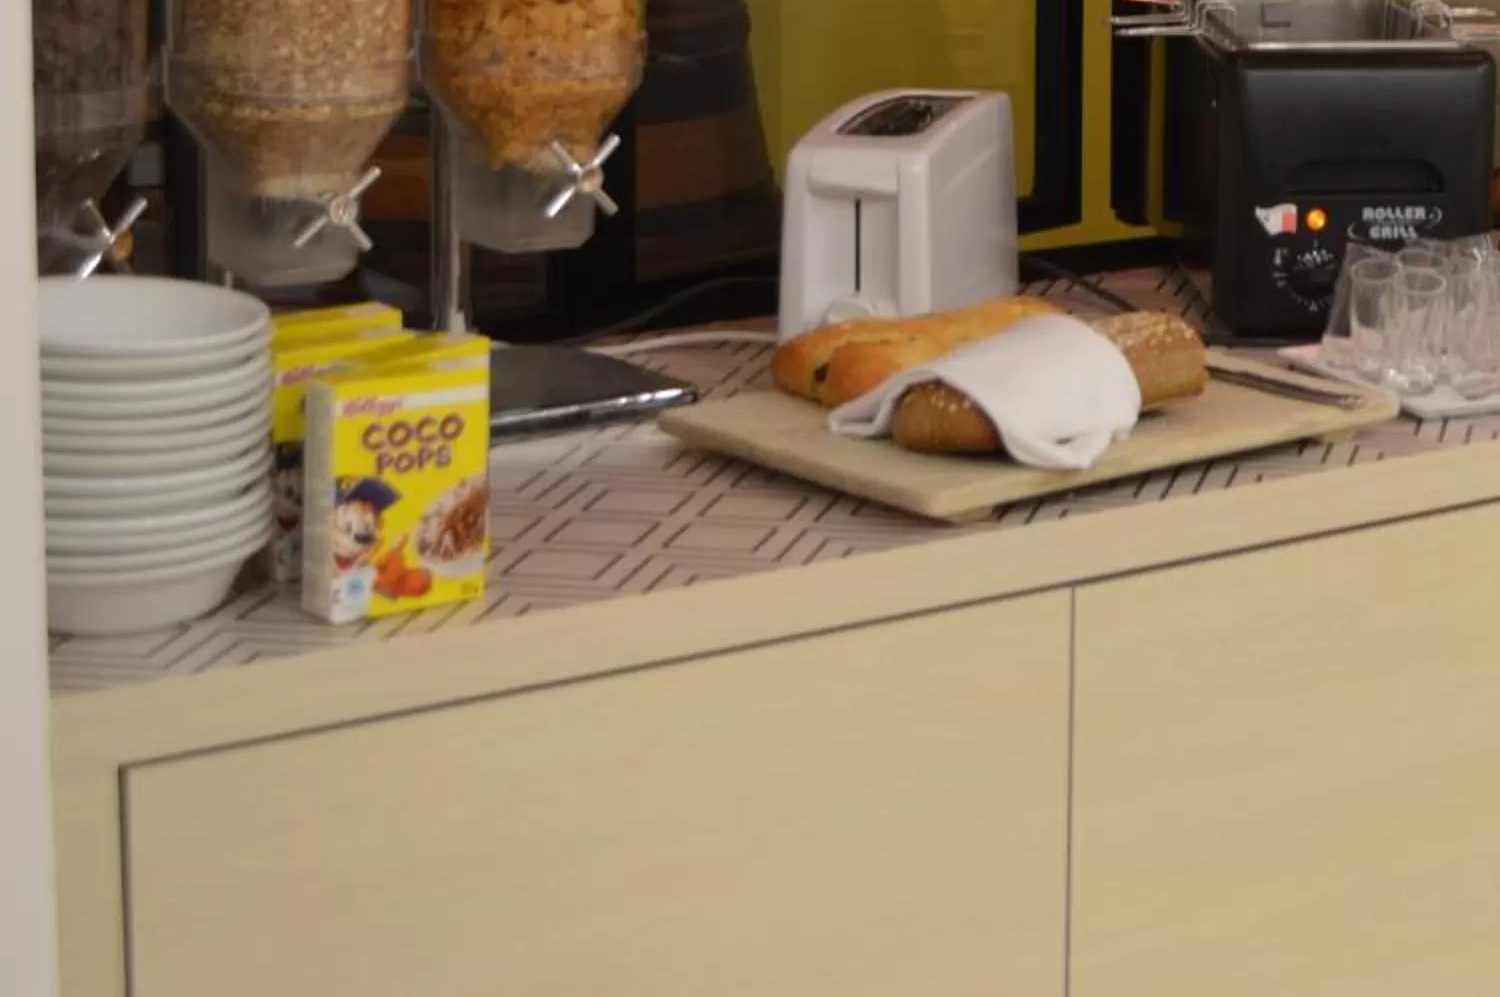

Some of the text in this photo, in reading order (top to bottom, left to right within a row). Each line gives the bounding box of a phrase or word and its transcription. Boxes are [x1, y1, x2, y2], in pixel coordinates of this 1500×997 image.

[1362, 206, 1426, 220] ROLLER
[1369, 225, 1418, 240] GRILL
[361, 414, 465, 451] COCO
[375, 444, 453, 475] POPS
